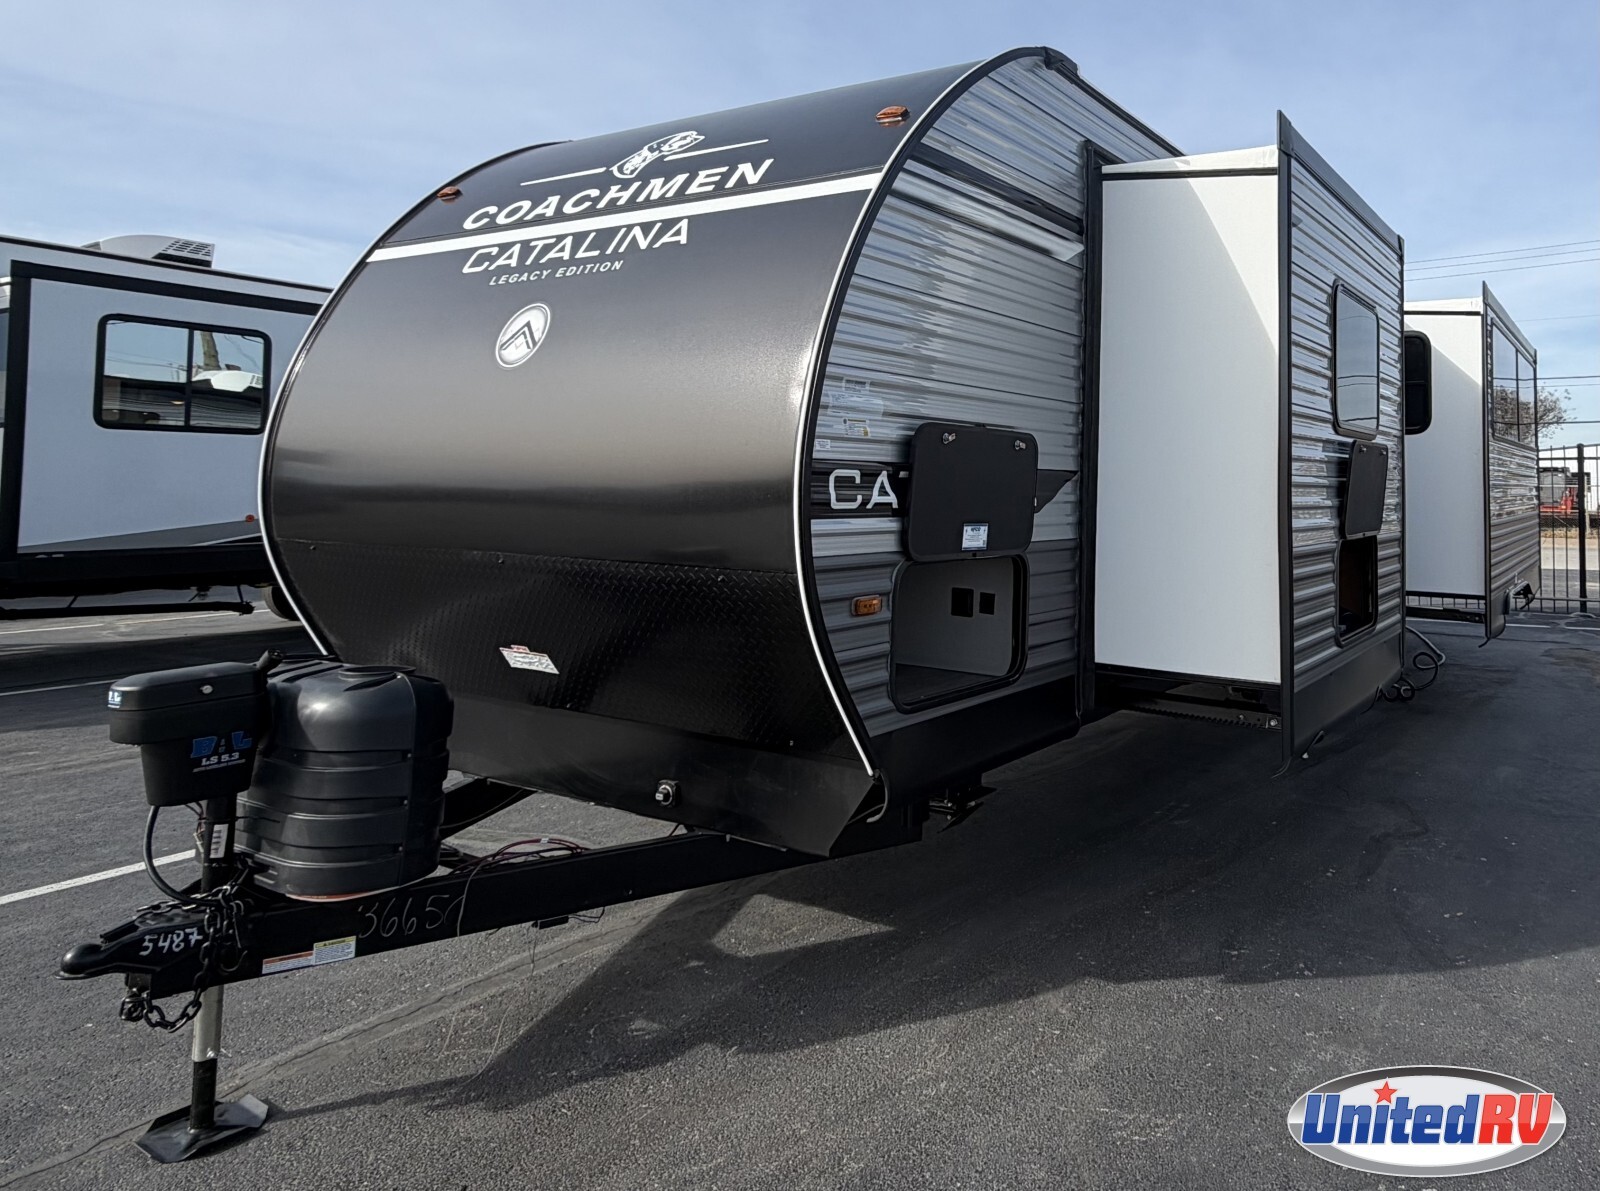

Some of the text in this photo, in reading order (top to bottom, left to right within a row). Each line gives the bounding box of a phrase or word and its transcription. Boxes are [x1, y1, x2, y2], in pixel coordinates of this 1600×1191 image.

[462, 158, 775, 230] COACHMEN
[461, 218, 690, 275] CATALINA
[489, 260, 624, 286] LEGACY EDITION
[828, 468, 909, 509] CA
[139, 927, 204, 956] 5487
